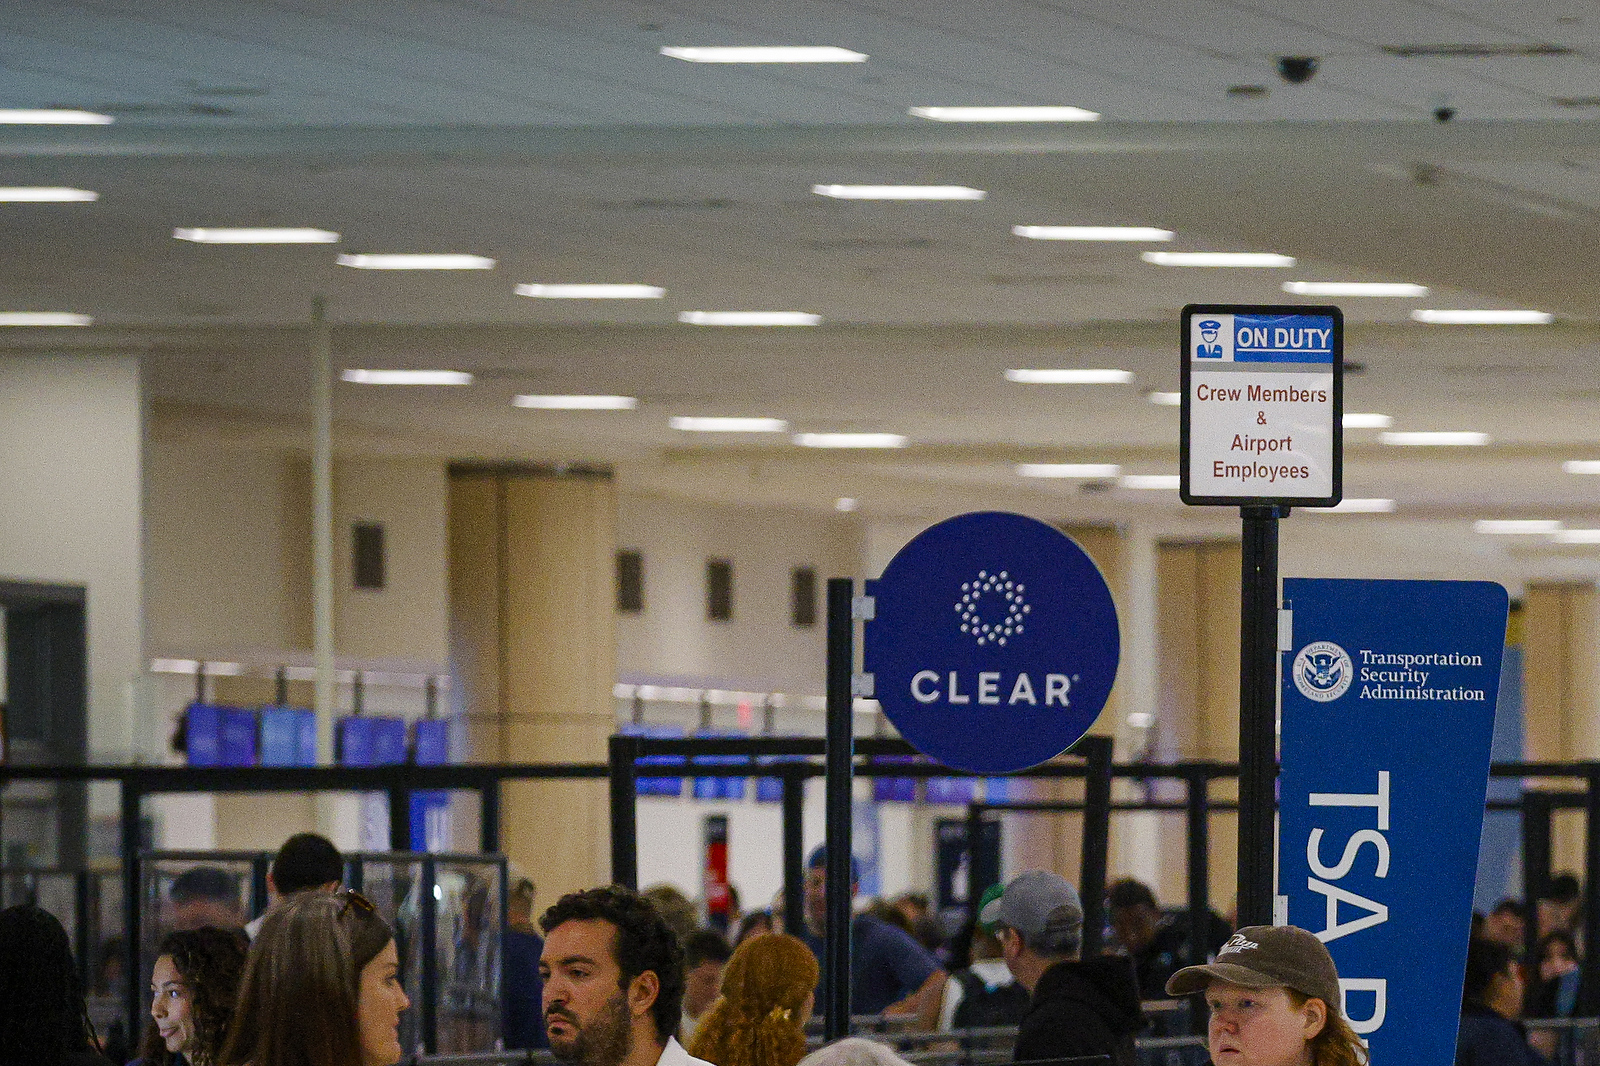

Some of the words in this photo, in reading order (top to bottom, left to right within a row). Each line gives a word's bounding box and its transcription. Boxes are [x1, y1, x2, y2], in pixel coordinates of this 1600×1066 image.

[1237, 328, 1268, 348] ON
[1275, 328, 1331, 349] DUTY
[1197, 384, 1241, 401] Crew
[1247, 385, 1327, 403] Members
[1256, 411, 1267, 425] &
[1231, 434, 1293, 455] Airport
[1213, 461, 1309, 482] Employees
[1359, 650, 1482, 669] Transportation
[1360, 668, 1429, 687] Security
[910, 670, 1072, 706] CLEAR
[1359, 684, 1486, 701] Administration
[1306, 771, 1390, 944] TSA
